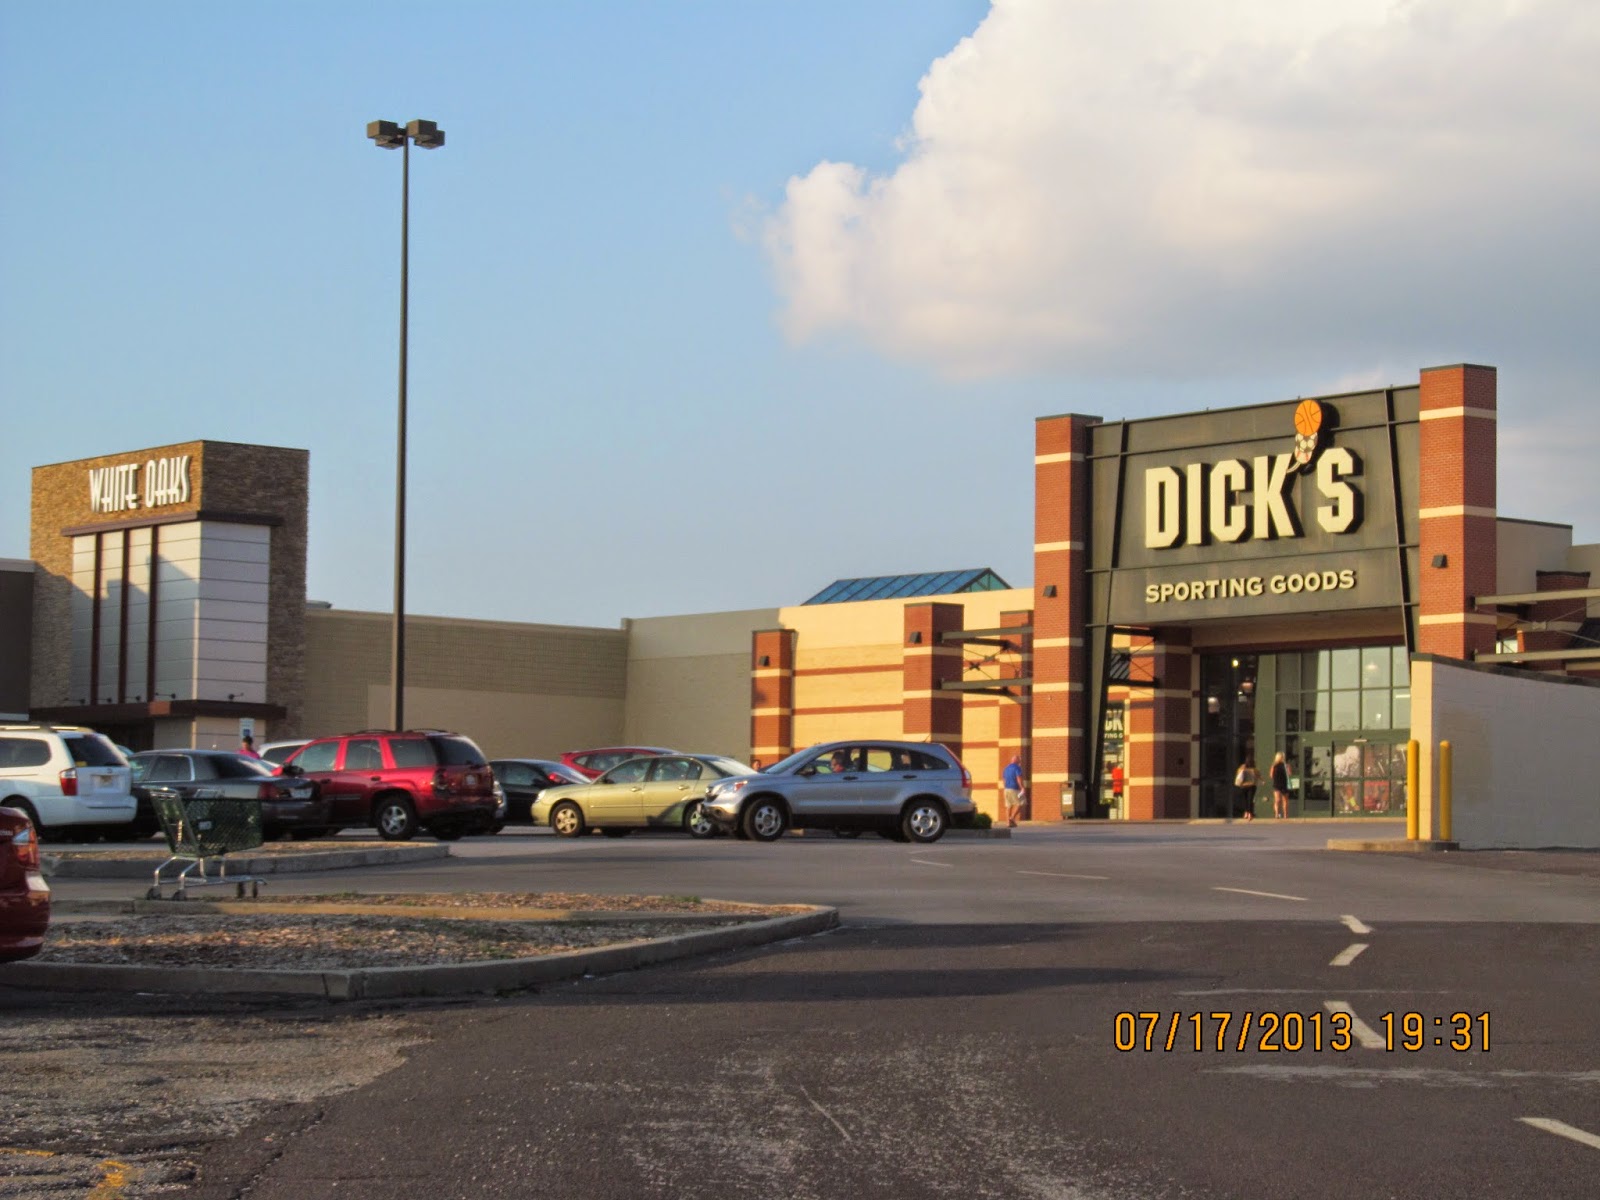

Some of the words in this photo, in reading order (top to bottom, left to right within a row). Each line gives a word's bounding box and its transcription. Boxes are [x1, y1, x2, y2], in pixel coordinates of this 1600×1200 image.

[89, 463, 139, 513] WHITE
[145, 455, 189, 508] OAKS
[1145, 445, 1355, 549] DICK'S
[1145, 575, 1264, 603] SPORTING
[1270, 569, 1356, 594] GOODS
